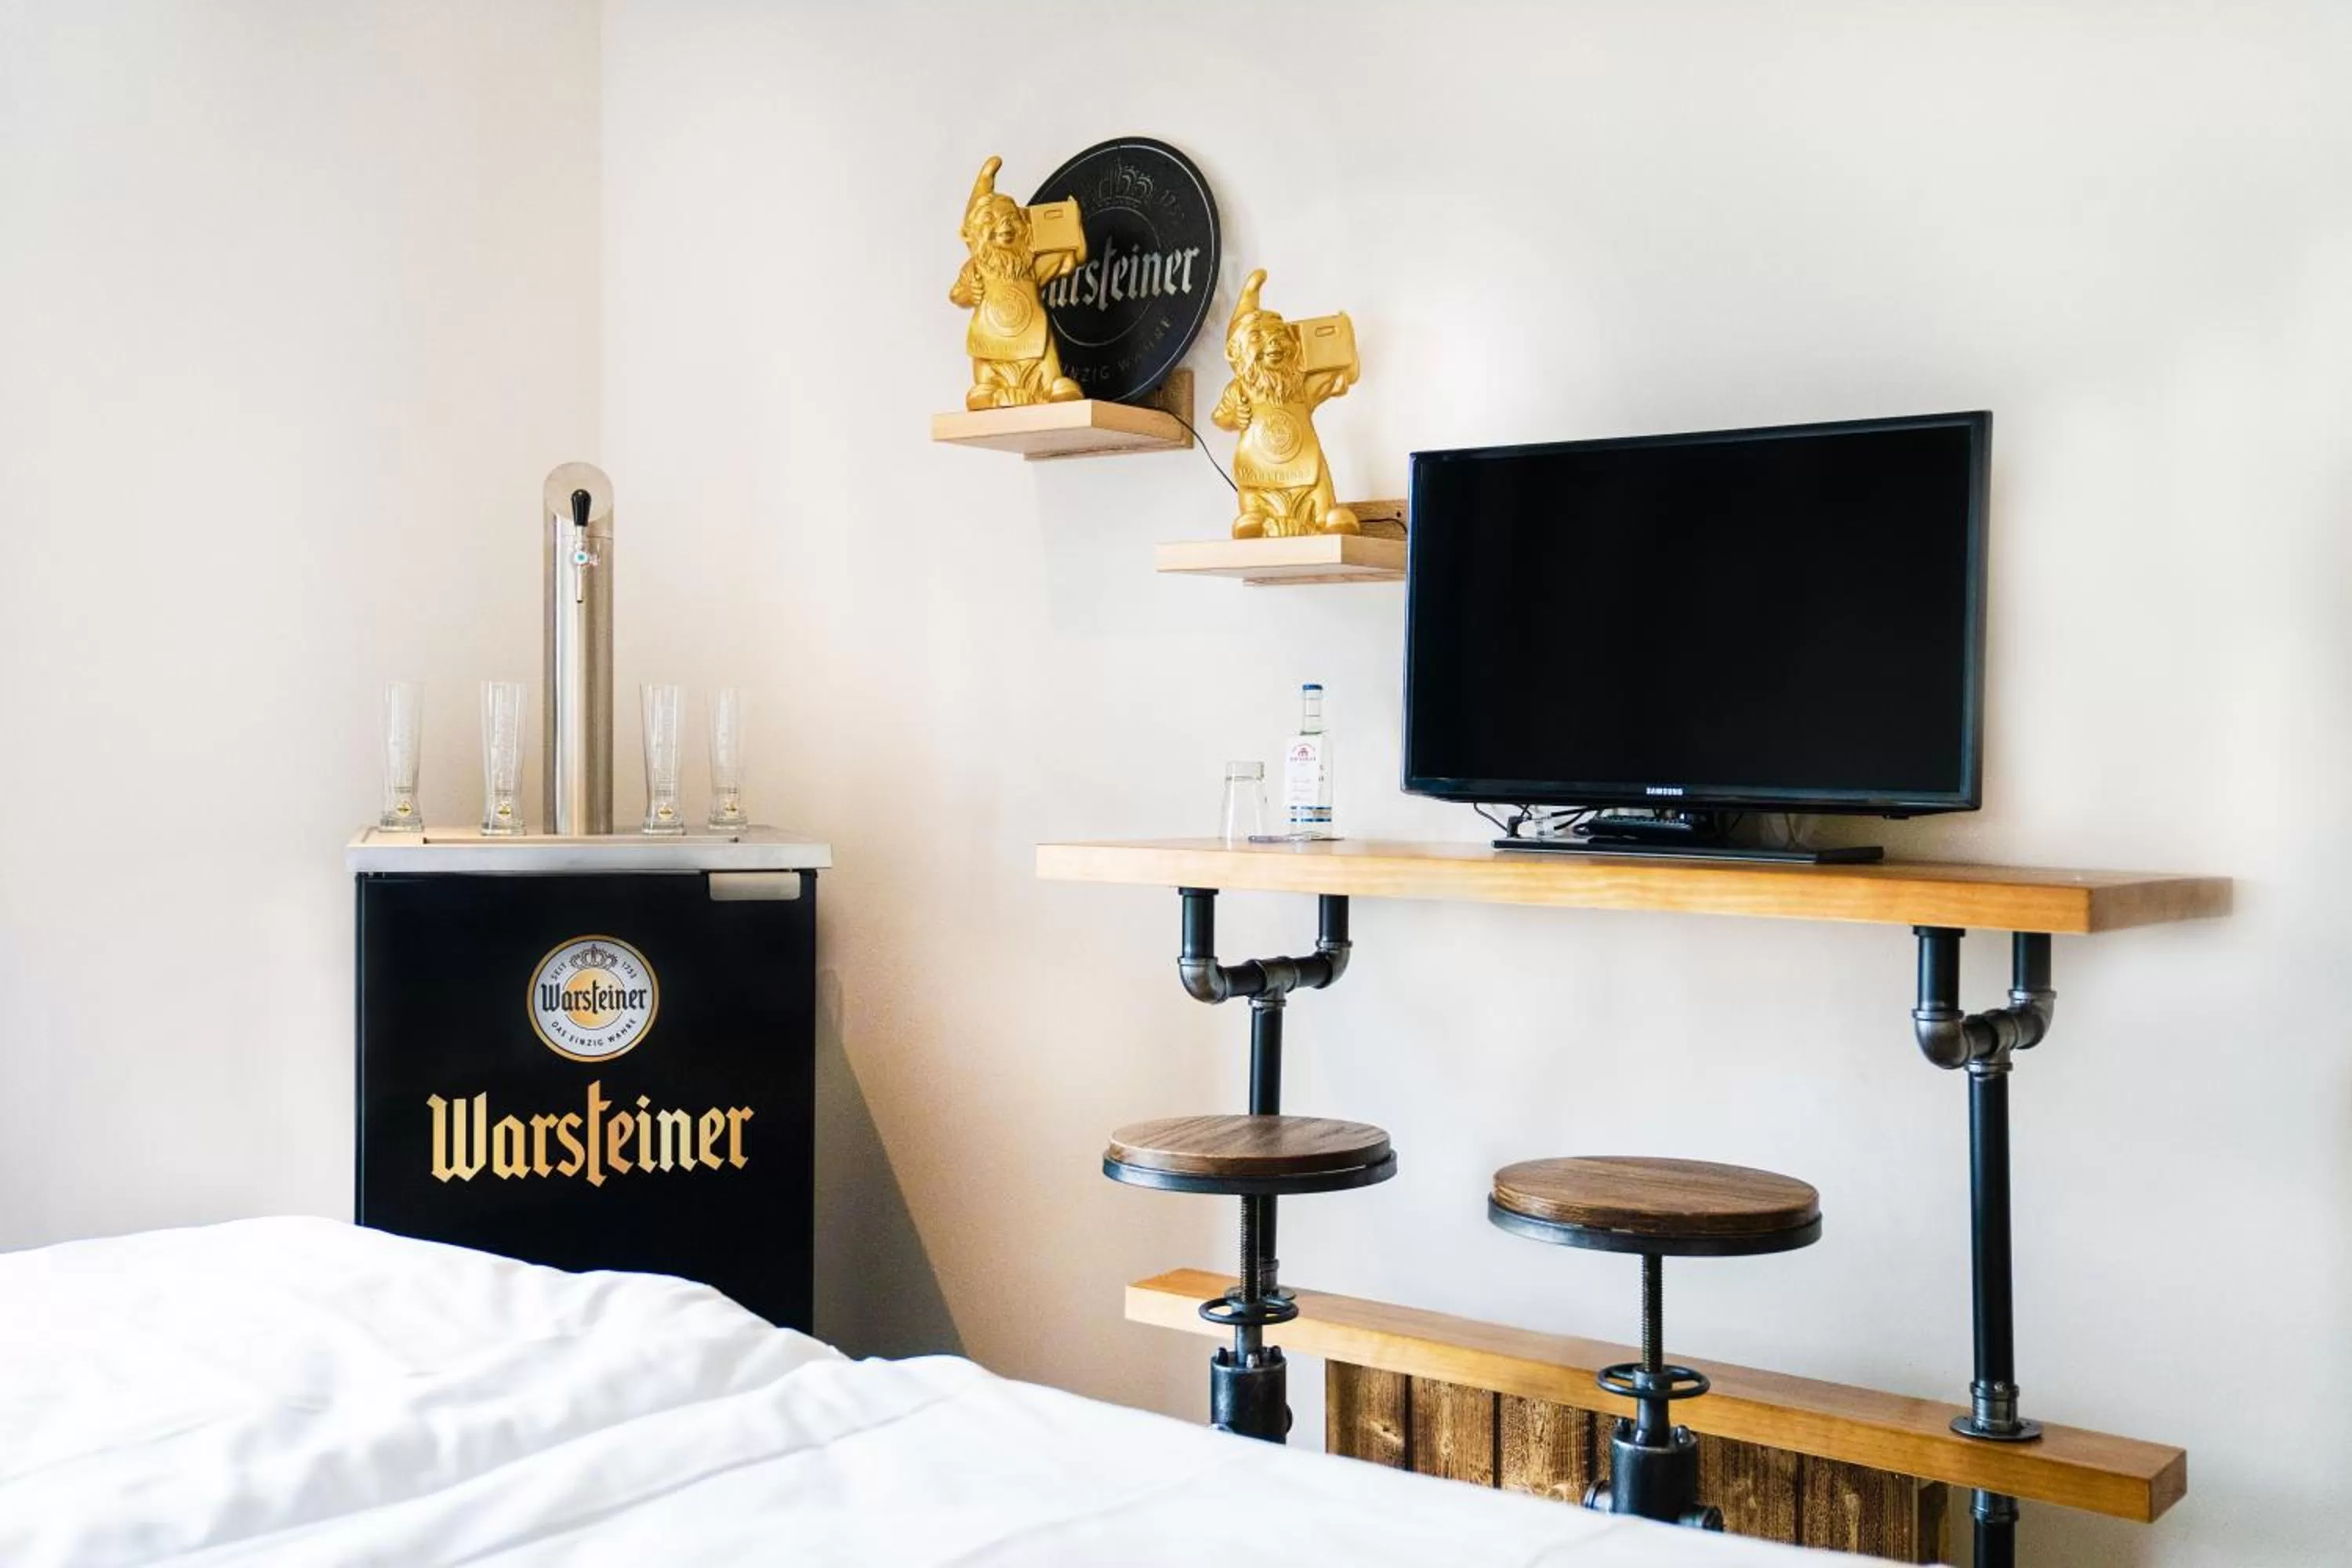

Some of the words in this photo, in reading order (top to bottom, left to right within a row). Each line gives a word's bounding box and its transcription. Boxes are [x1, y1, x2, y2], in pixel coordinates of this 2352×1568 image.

[1042, 235, 1200, 311] arsteiner
[541, 980, 647, 1014] Warsteiner
[551, 1021, 567, 1037] DAS
[569, 1034, 604, 1047] EINZIG
[426, 1080, 755, 1188] Warsteiner
